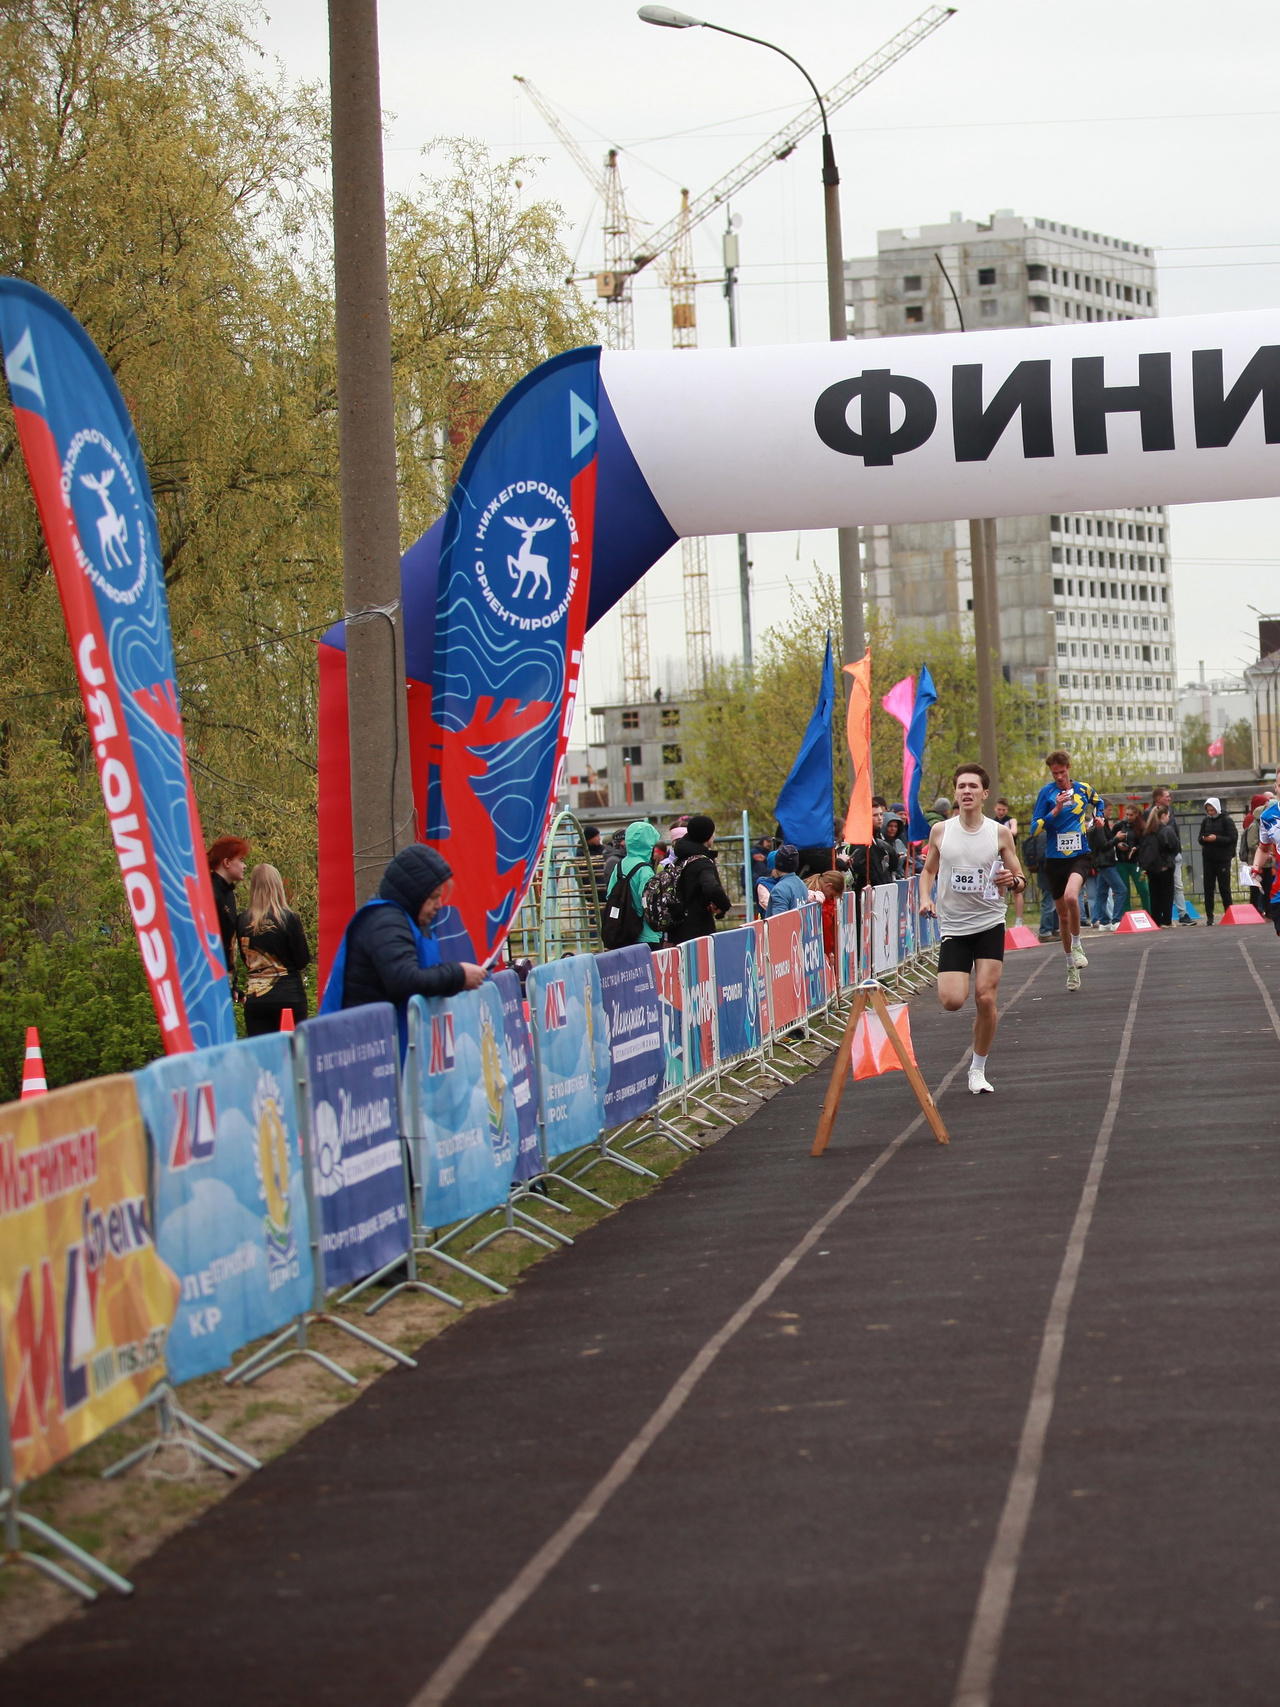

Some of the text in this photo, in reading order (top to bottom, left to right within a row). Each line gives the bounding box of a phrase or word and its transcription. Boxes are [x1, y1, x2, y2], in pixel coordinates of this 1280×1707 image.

[475, 480, 580, 545] НИЖЕГОРОДСКОЕ
[475, 560, 579, 631] ОРИЕНТИРОВАНИЕ
[955, 874, 974, 884] 362
